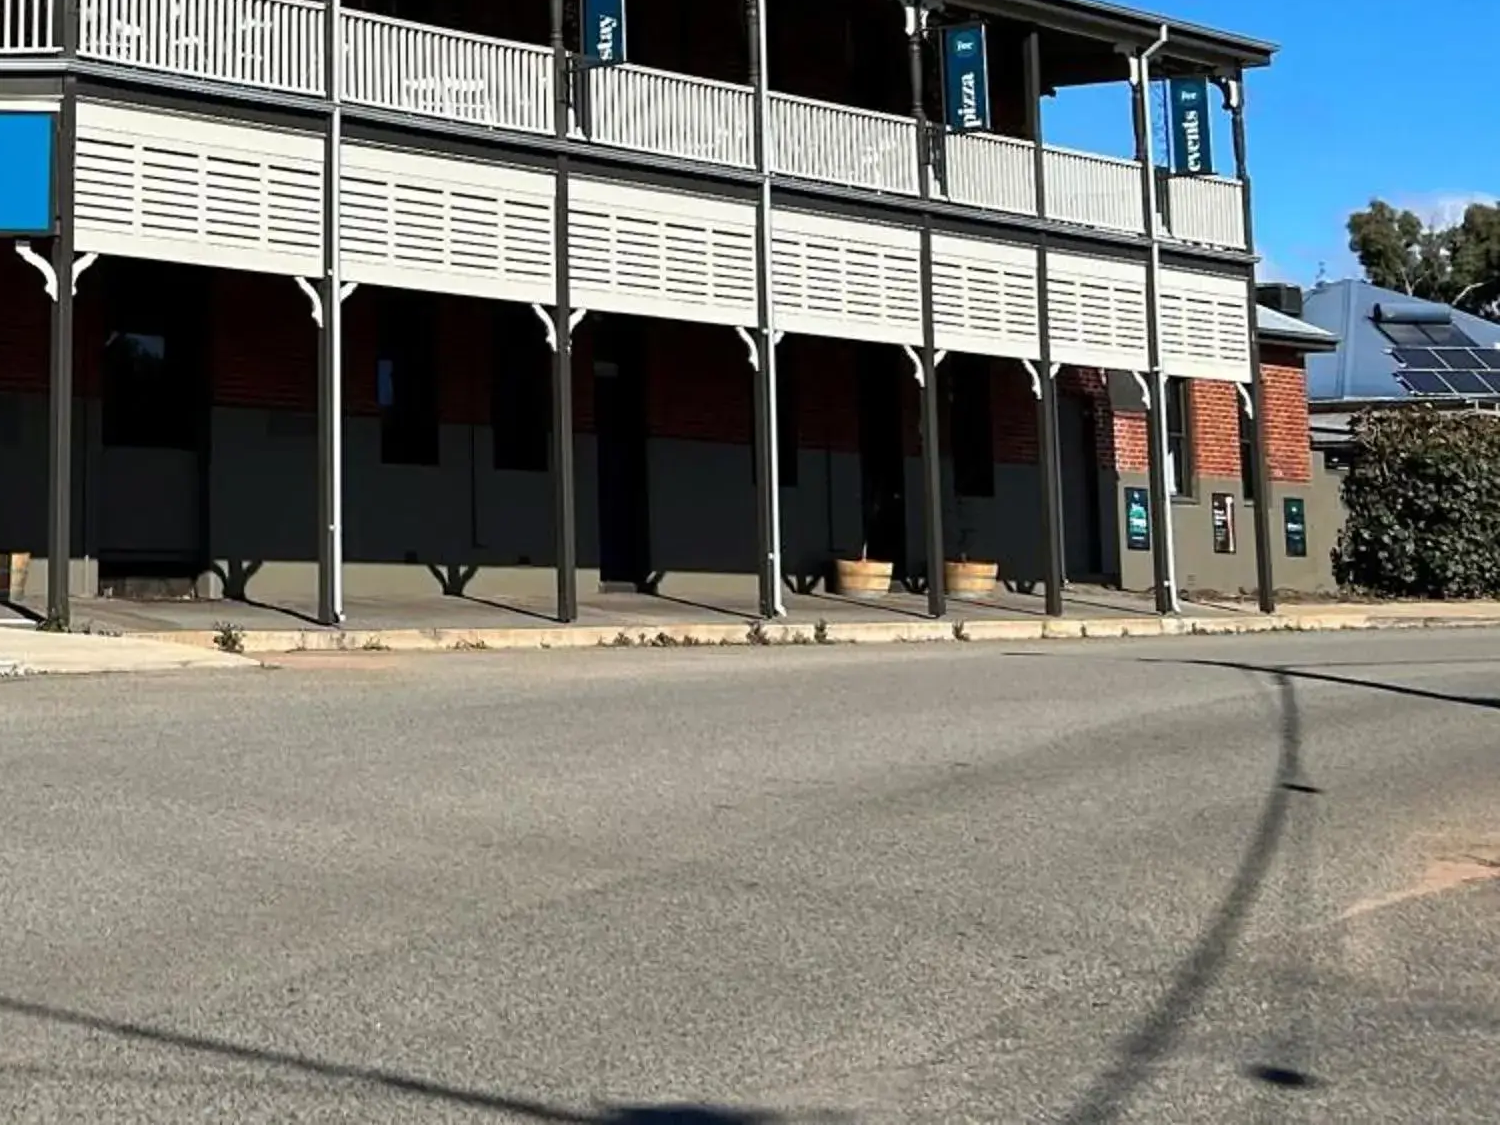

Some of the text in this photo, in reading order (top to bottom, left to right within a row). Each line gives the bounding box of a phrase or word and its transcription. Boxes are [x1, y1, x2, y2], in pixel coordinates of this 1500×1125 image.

[597, 14, 618, 61] stay
[958, 72, 983, 128] pizza
[1182, 110, 1201, 172] events
